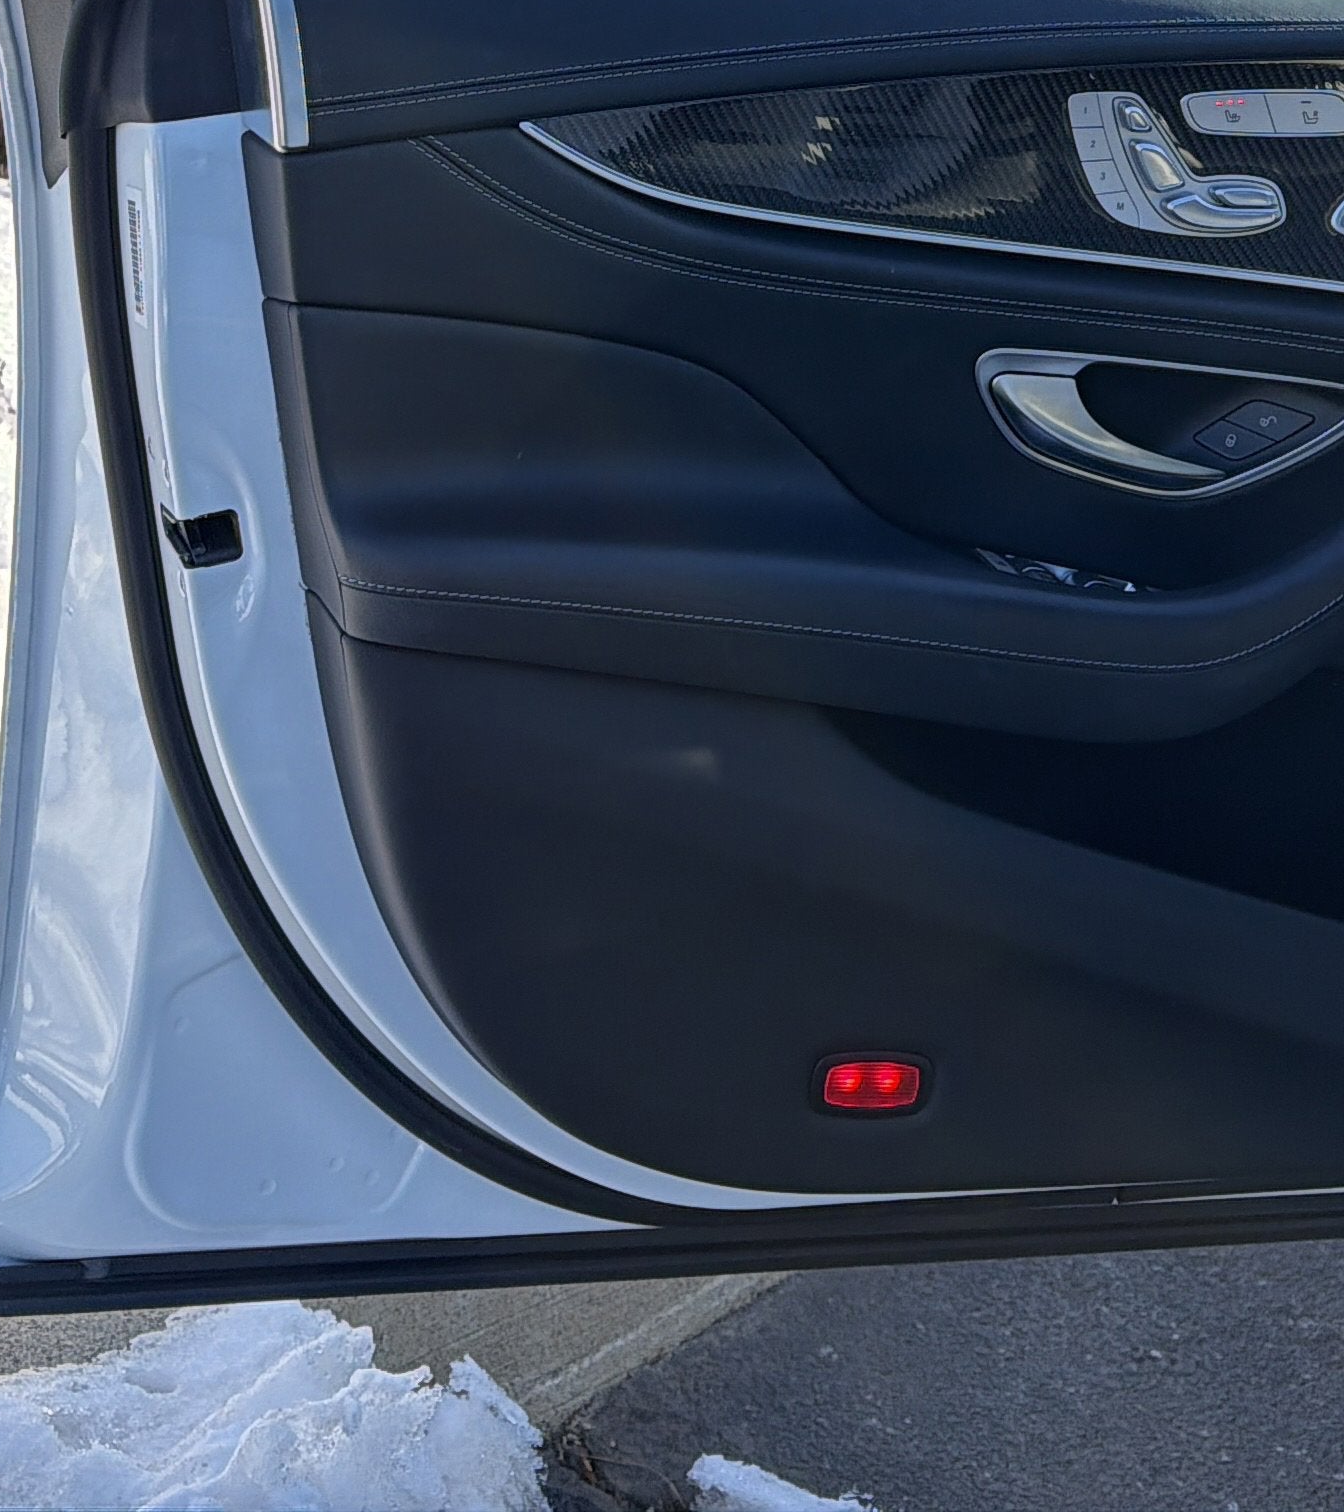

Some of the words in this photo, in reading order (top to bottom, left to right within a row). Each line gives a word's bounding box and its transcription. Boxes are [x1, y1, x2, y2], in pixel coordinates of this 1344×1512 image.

[1089, 139, 1096, 148] 2
[1099, 172, 1106, 181] 3
[1116, 202, 1125, 211] M
